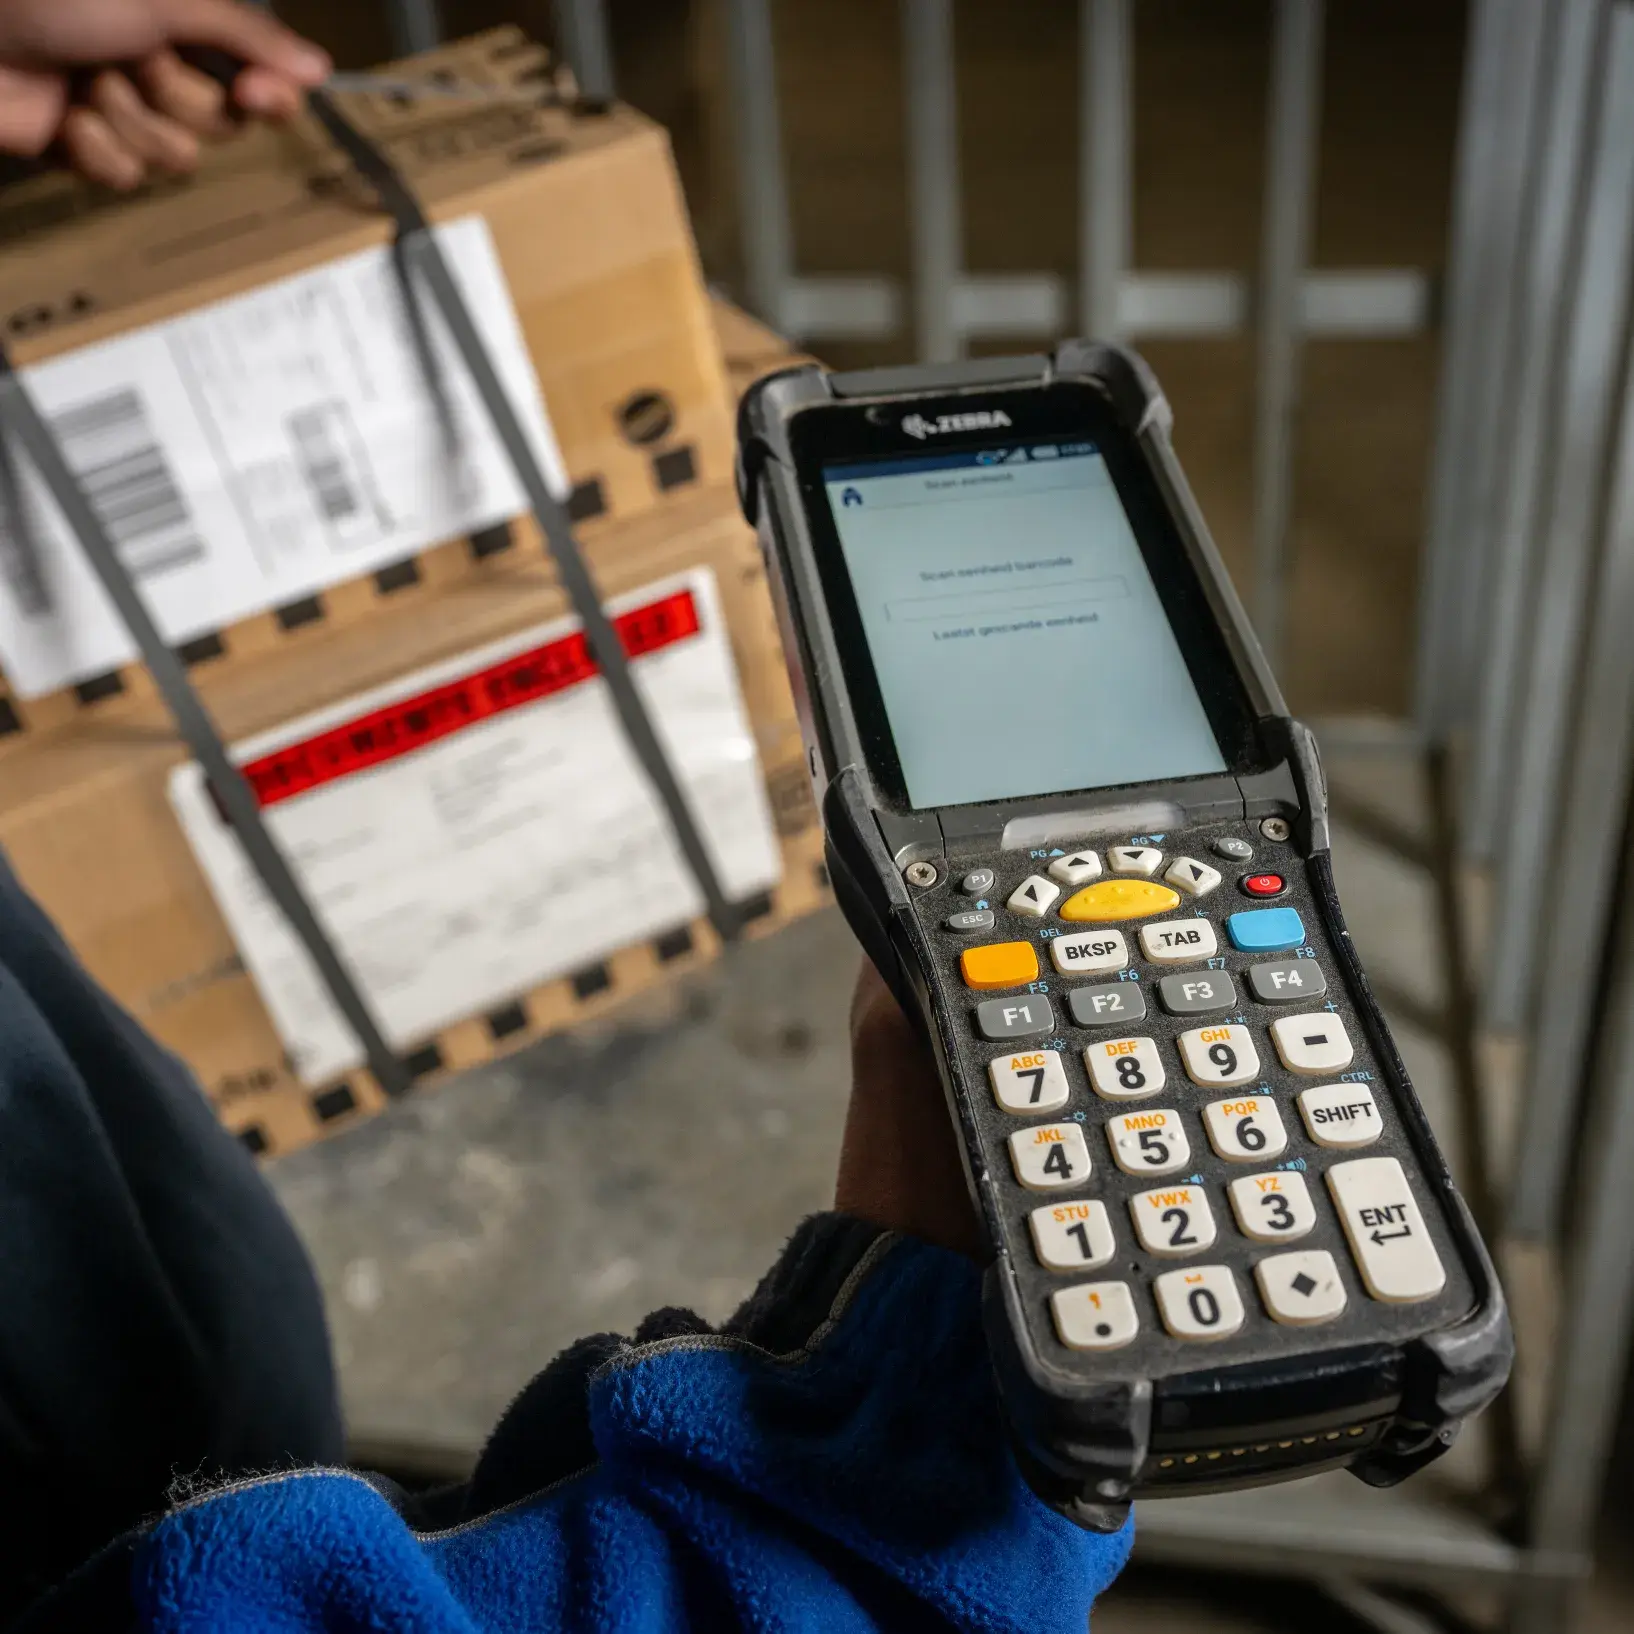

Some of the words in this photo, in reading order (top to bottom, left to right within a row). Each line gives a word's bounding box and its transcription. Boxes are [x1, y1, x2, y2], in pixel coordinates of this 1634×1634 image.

[936, 410, 1013, 433] ZEBRA
[919, 569, 955, 582] Scan
[1014, 556, 1073, 572] barcode
[1131, 836, 1148, 846] PG
[1227, 841, 1245, 852] P2
[1030, 849, 1047, 859] PG
[971, 874, 986, 884] P1
[961, 914, 984, 924] ESC
[1039, 928, 1064, 939] DEL
[1160, 930, 1201, 948] TAB
[1065, 940, 1118, 960] BKSP
[1295, 947, 1316, 960] F8
[1208, 957, 1227, 971] F7
[1119, 968, 1140, 982] F6
[1270, 969, 1303, 989] F4
[1028, 981, 1049, 995] F5
[1182, 981, 1214, 1002] F3
[1091, 993, 1125, 1013] F2
[1002, 1005, 1034, 1027] F1
[1200, 1029, 1231, 1044] GHI
[1105, 1041, 1138, 1057] DEF
[1010, 1053, 1046, 1071] ABC
[1209, 1043, 1238, 1076] 9
[1116, 1057, 1146, 1090] 8
[1341, 1071, 1375, 1083] CTRL
[1016, 1068, 1046, 1104] 7
[1222, 1100, 1259, 1117] PQR
[1313, 1101, 1373, 1125] SHIFT
[1124, 1113, 1166, 1131] MNO
[1033, 1128, 1066, 1144] JKL
[1235, 1117, 1266, 1151] 6
[1138, 1130, 1170, 1165] 5
[1043, 1143, 1073, 1180] 4
[1255, 1177, 1282, 1192] YZ
[1147, 1190, 1192, 1209] VWX
[1053, 1205, 1089, 1222] STU
[1261, 1194, 1295, 1230] 3
[1360, 1203, 1408, 1228] ENT
[1161, 1208, 1197, 1247] 2
[1066, 1222, 1094, 1260] 1
[1188, 1288, 1220, 1326] 0
